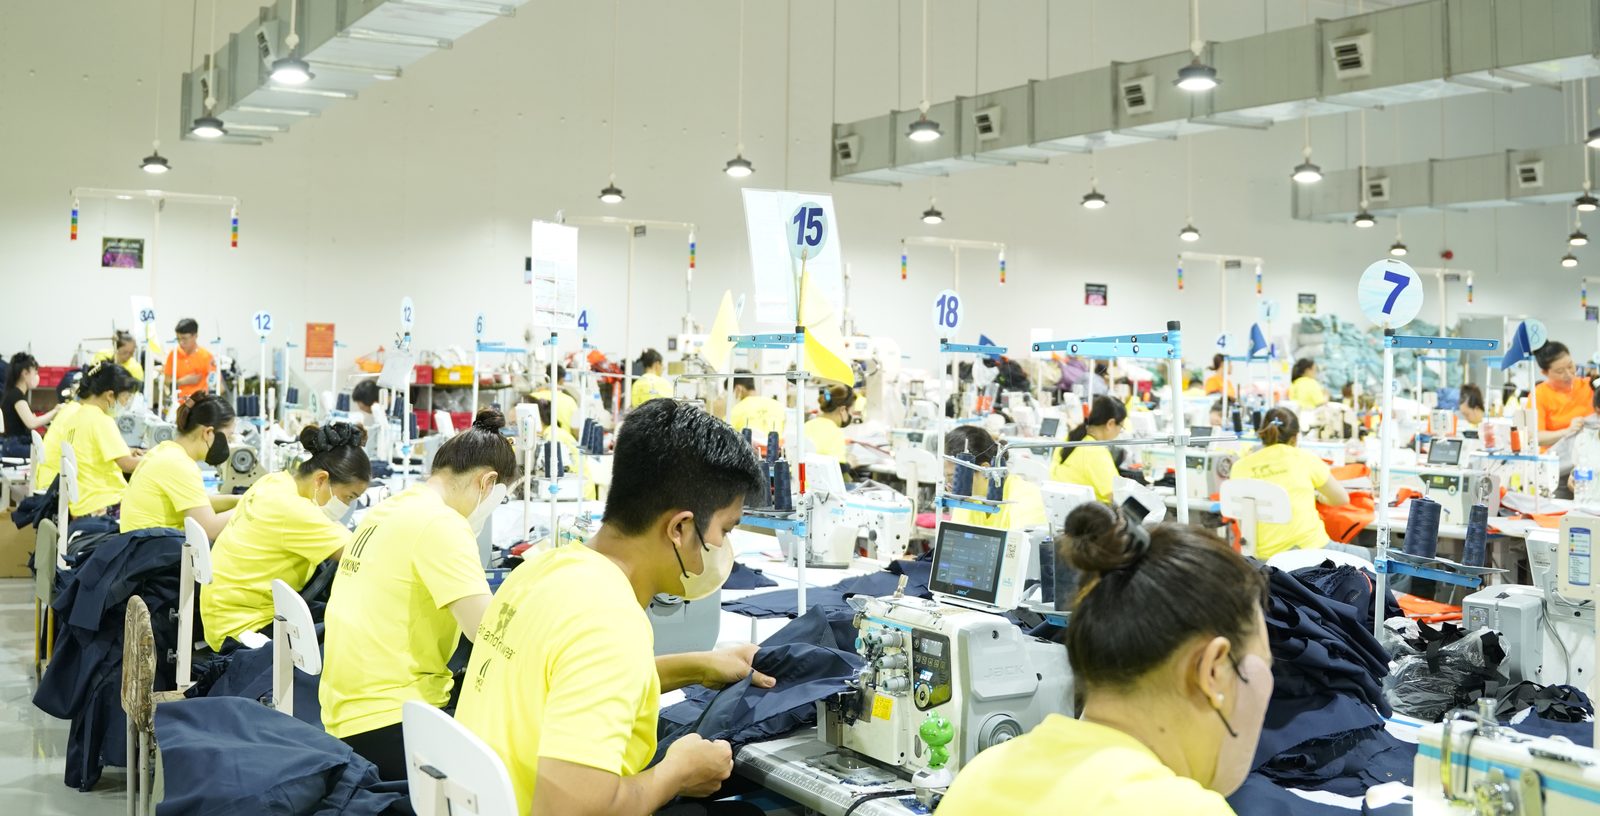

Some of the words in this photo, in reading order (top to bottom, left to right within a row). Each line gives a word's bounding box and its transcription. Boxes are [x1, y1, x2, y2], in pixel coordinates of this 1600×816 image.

[793, 207, 823, 246] 15
[1382, 270, 1410, 314] 7
[140, 310, 155, 322] 3A
[404, 306, 411, 322] 12
[577, 309, 589, 331] 4
[936, 294, 959, 328] 18
[255, 314, 271, 330] 12
[476, 315, 482, 333] 6
[1217, 335, 1226, 348] 4
[1530, 323, 1541, 345] 8
